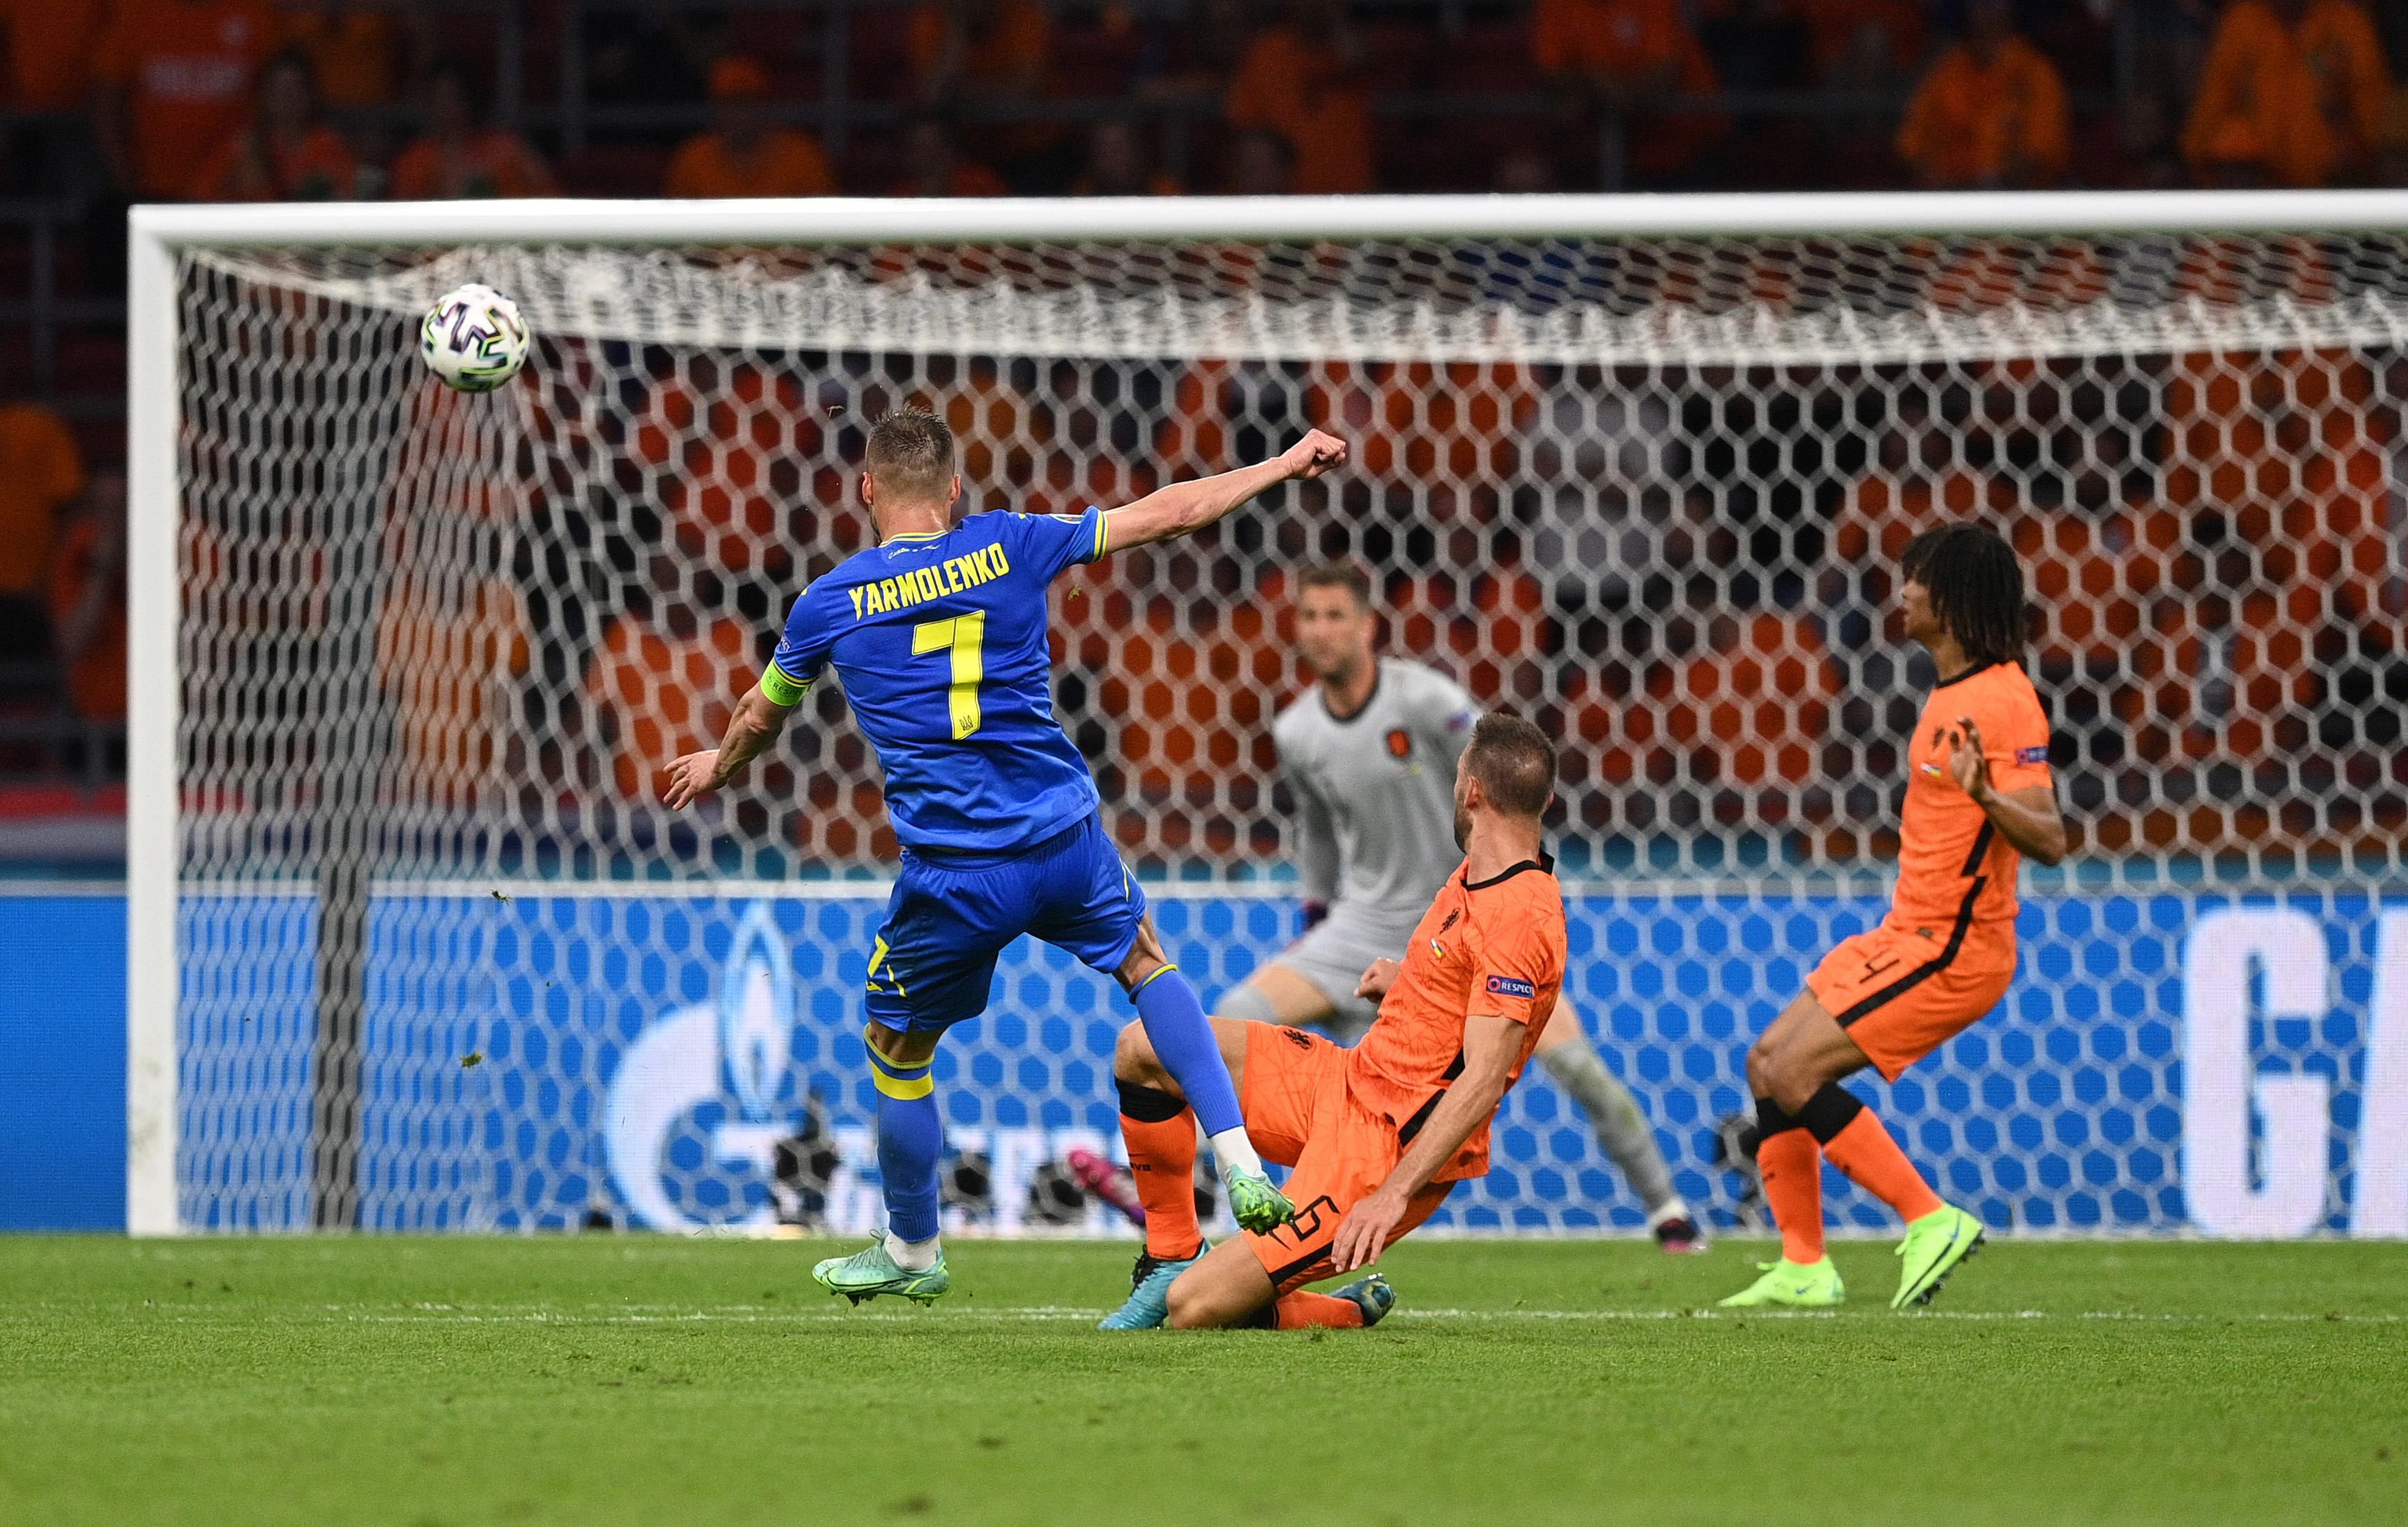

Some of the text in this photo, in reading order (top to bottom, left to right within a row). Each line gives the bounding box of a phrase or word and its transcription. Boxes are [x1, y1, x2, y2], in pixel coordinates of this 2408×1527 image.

[848, 542, 1010, 621] YARMOLENKO
[912, 609, 985, 740] 7
[1501, 982, 1532, 994] RESPECT
[1858, 946, 1900, 985] 4
[2181, 904, 2408, 1239] G
